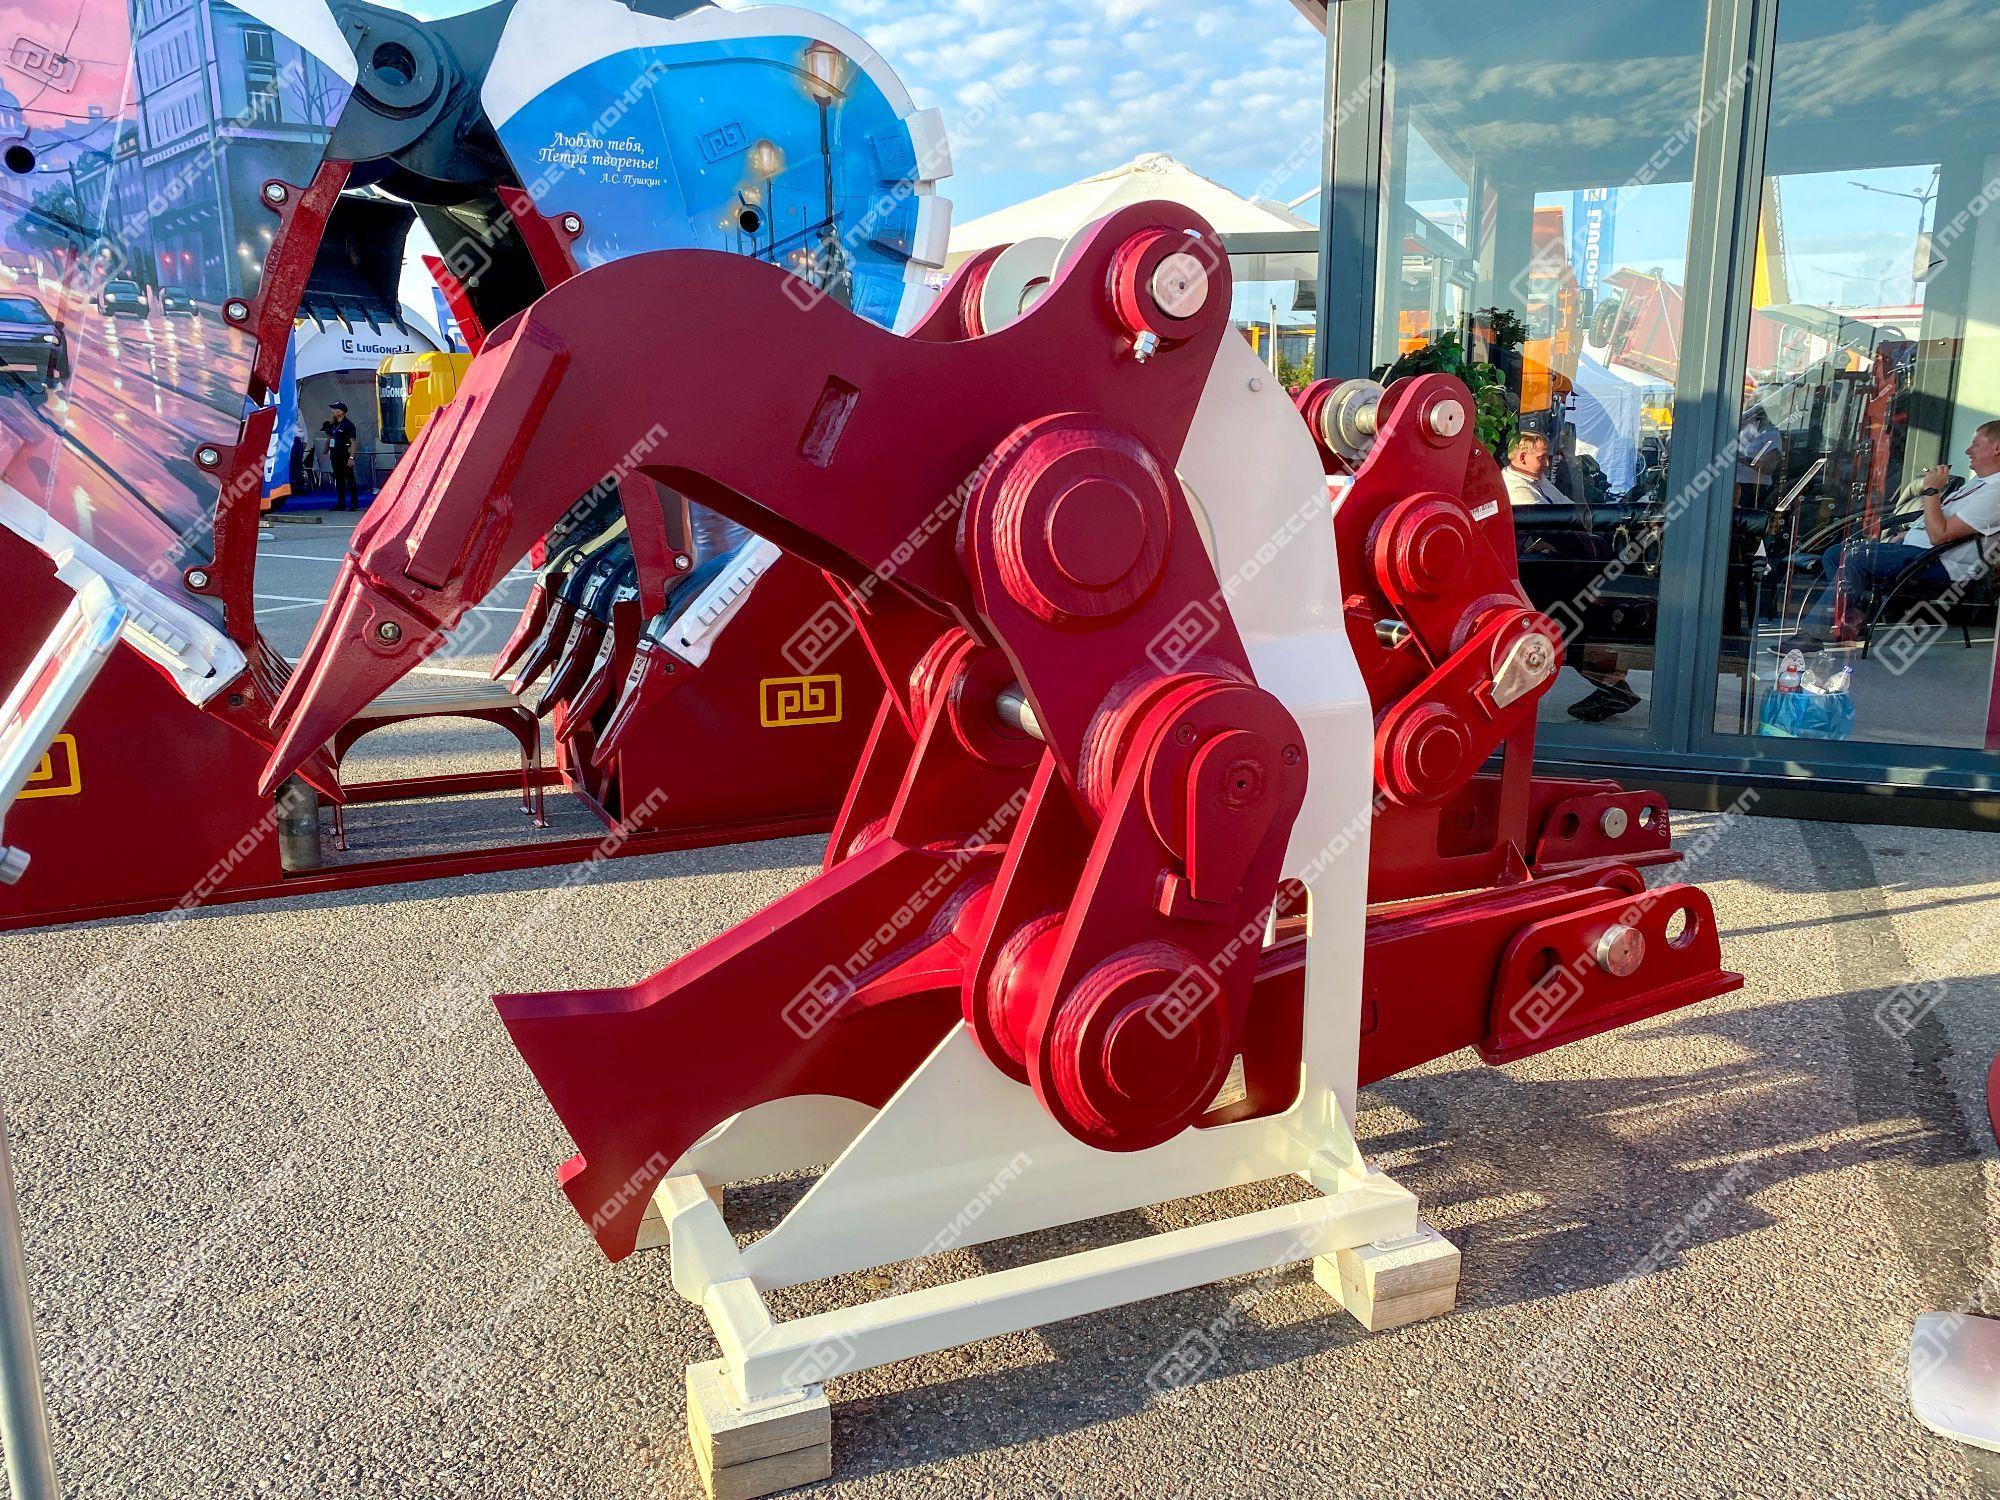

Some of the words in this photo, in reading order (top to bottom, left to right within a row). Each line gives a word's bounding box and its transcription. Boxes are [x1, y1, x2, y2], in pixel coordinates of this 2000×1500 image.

[550, 132, 603, 149] Люблю
[608, 136, 645, 155] тебя,
[538, 148, 587, 168] Петра
[592, 157, 659, 171] творенье!
[623, 174, 661, 188] Пушкин
